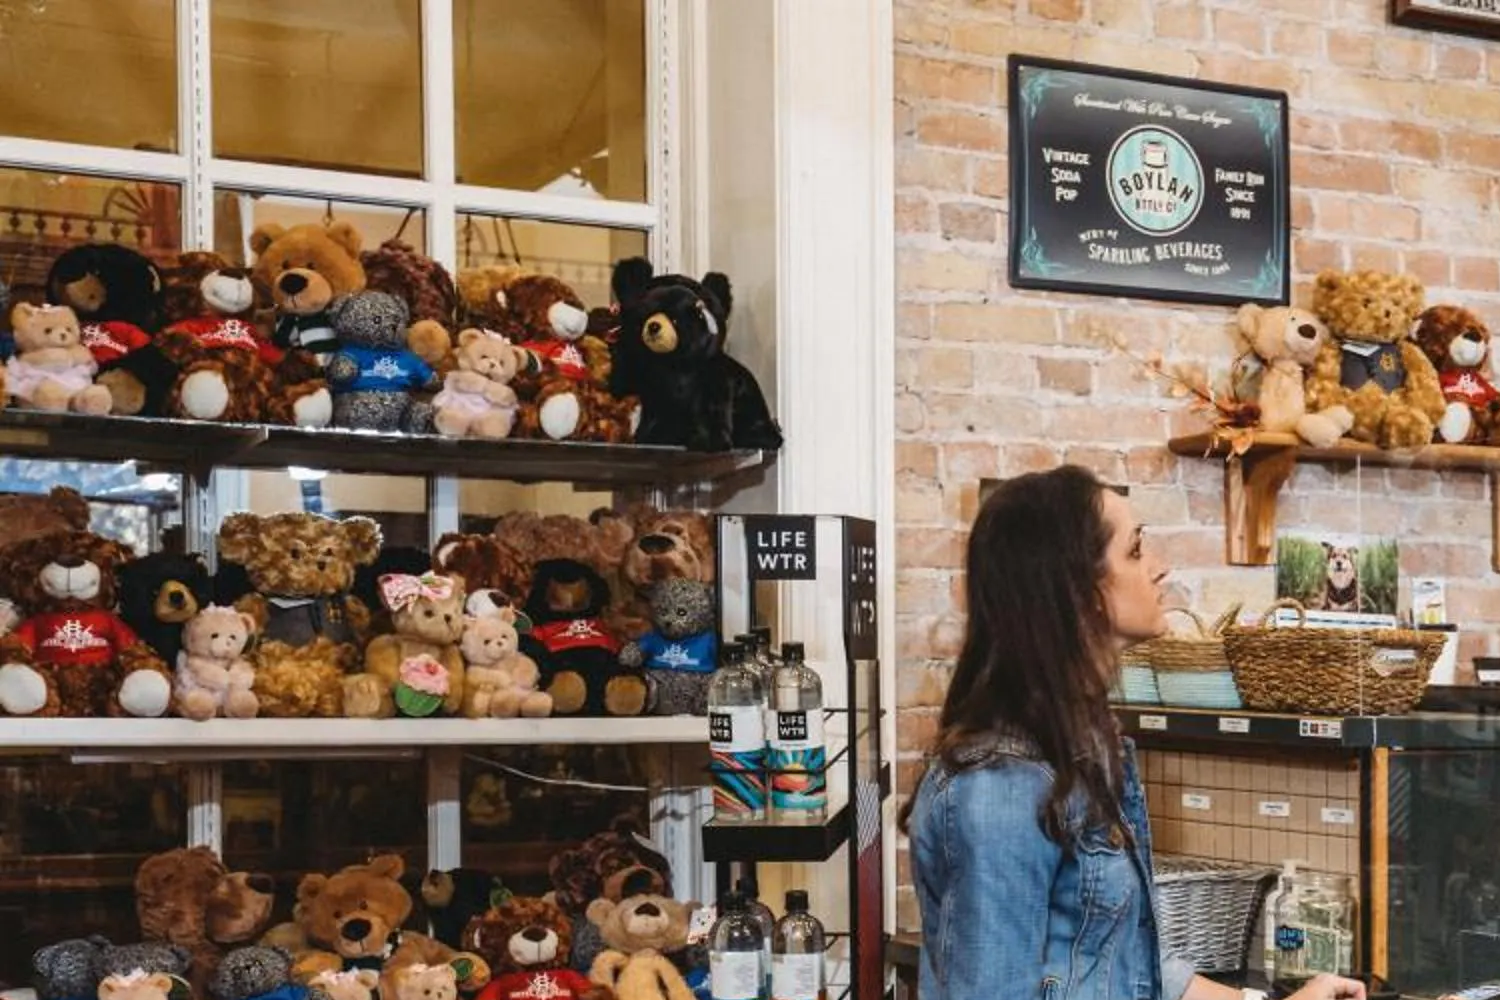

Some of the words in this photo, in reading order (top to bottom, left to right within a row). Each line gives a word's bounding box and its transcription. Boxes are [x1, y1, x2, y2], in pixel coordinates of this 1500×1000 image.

[1055, 187, 1079, 202] POP
[1119, 171, 1194, 203] BOYLAN
[1088, 243, 1150, 265] SPARKLING
[1154, 241, 1223, 260] BEVERAGES
[757, 531, 807, 548] LIFE
[757, 553, 807, 571] WTR
[780, 715, 804, 725] LIFE
[780, 727, 804, 736] WTR
